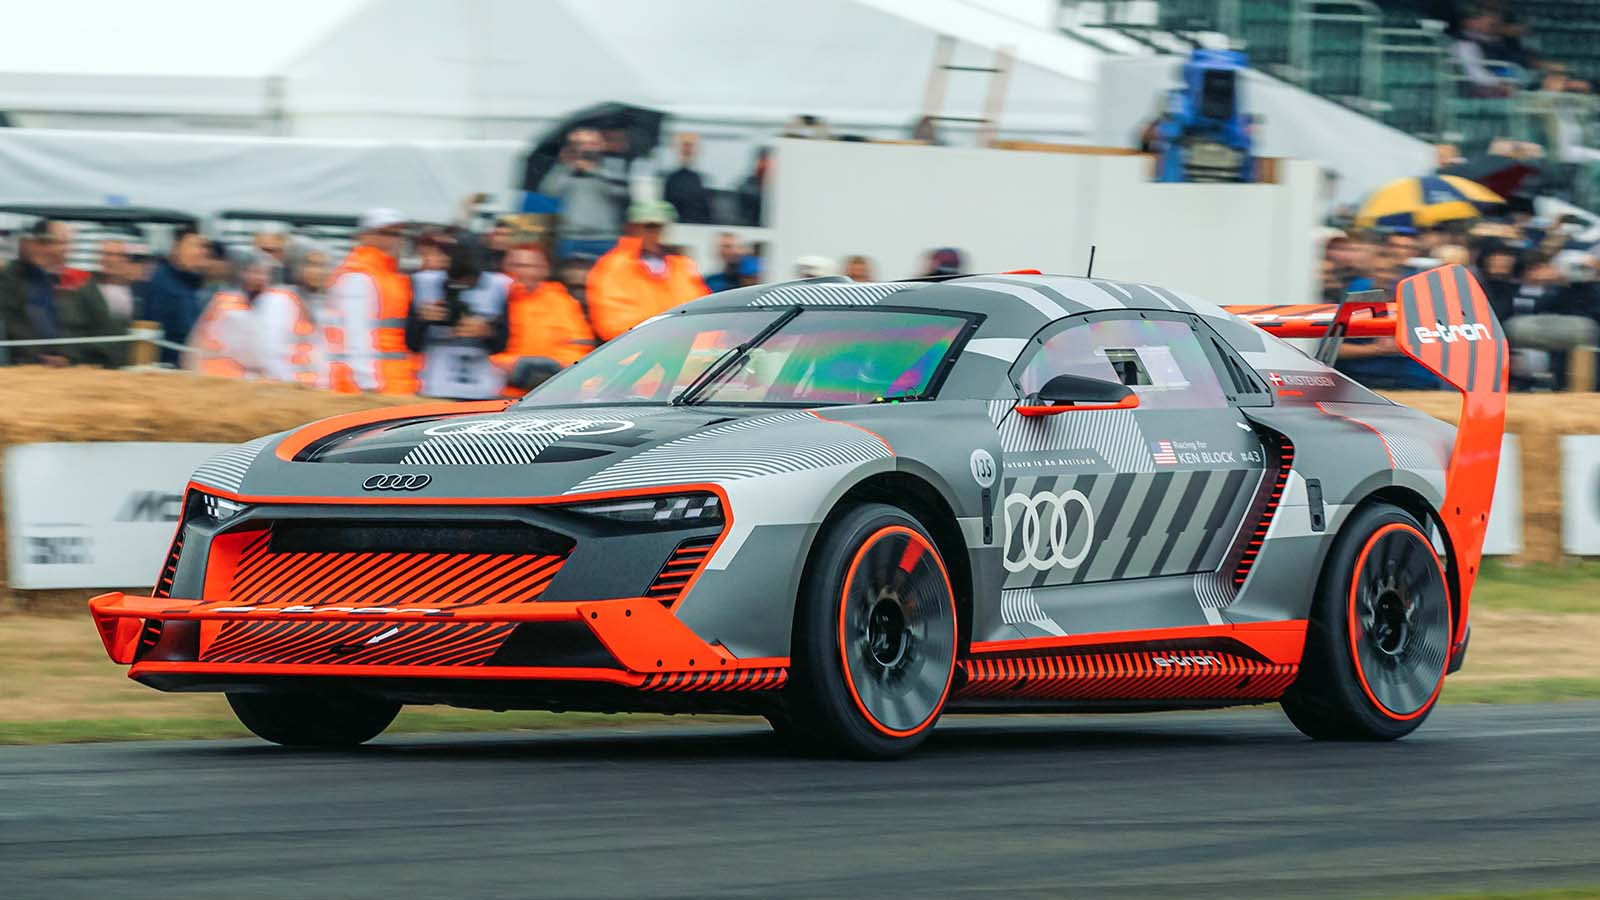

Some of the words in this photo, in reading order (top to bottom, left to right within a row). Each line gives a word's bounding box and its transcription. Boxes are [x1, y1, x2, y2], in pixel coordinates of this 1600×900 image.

[1414, 322, 1492, 343] e-tron
[1172, 440, 1196, 450] Racing
[1058, 458, 1096, 466] Attitude
[1178, 453, 1199, 464] KEN
[1201, 451, 1237, 464] BLOCK
[1240, 451, 1261, 462] #43
[974, 459, 992, 478] 135
[1152, 655, 1222, 667] e-tron
